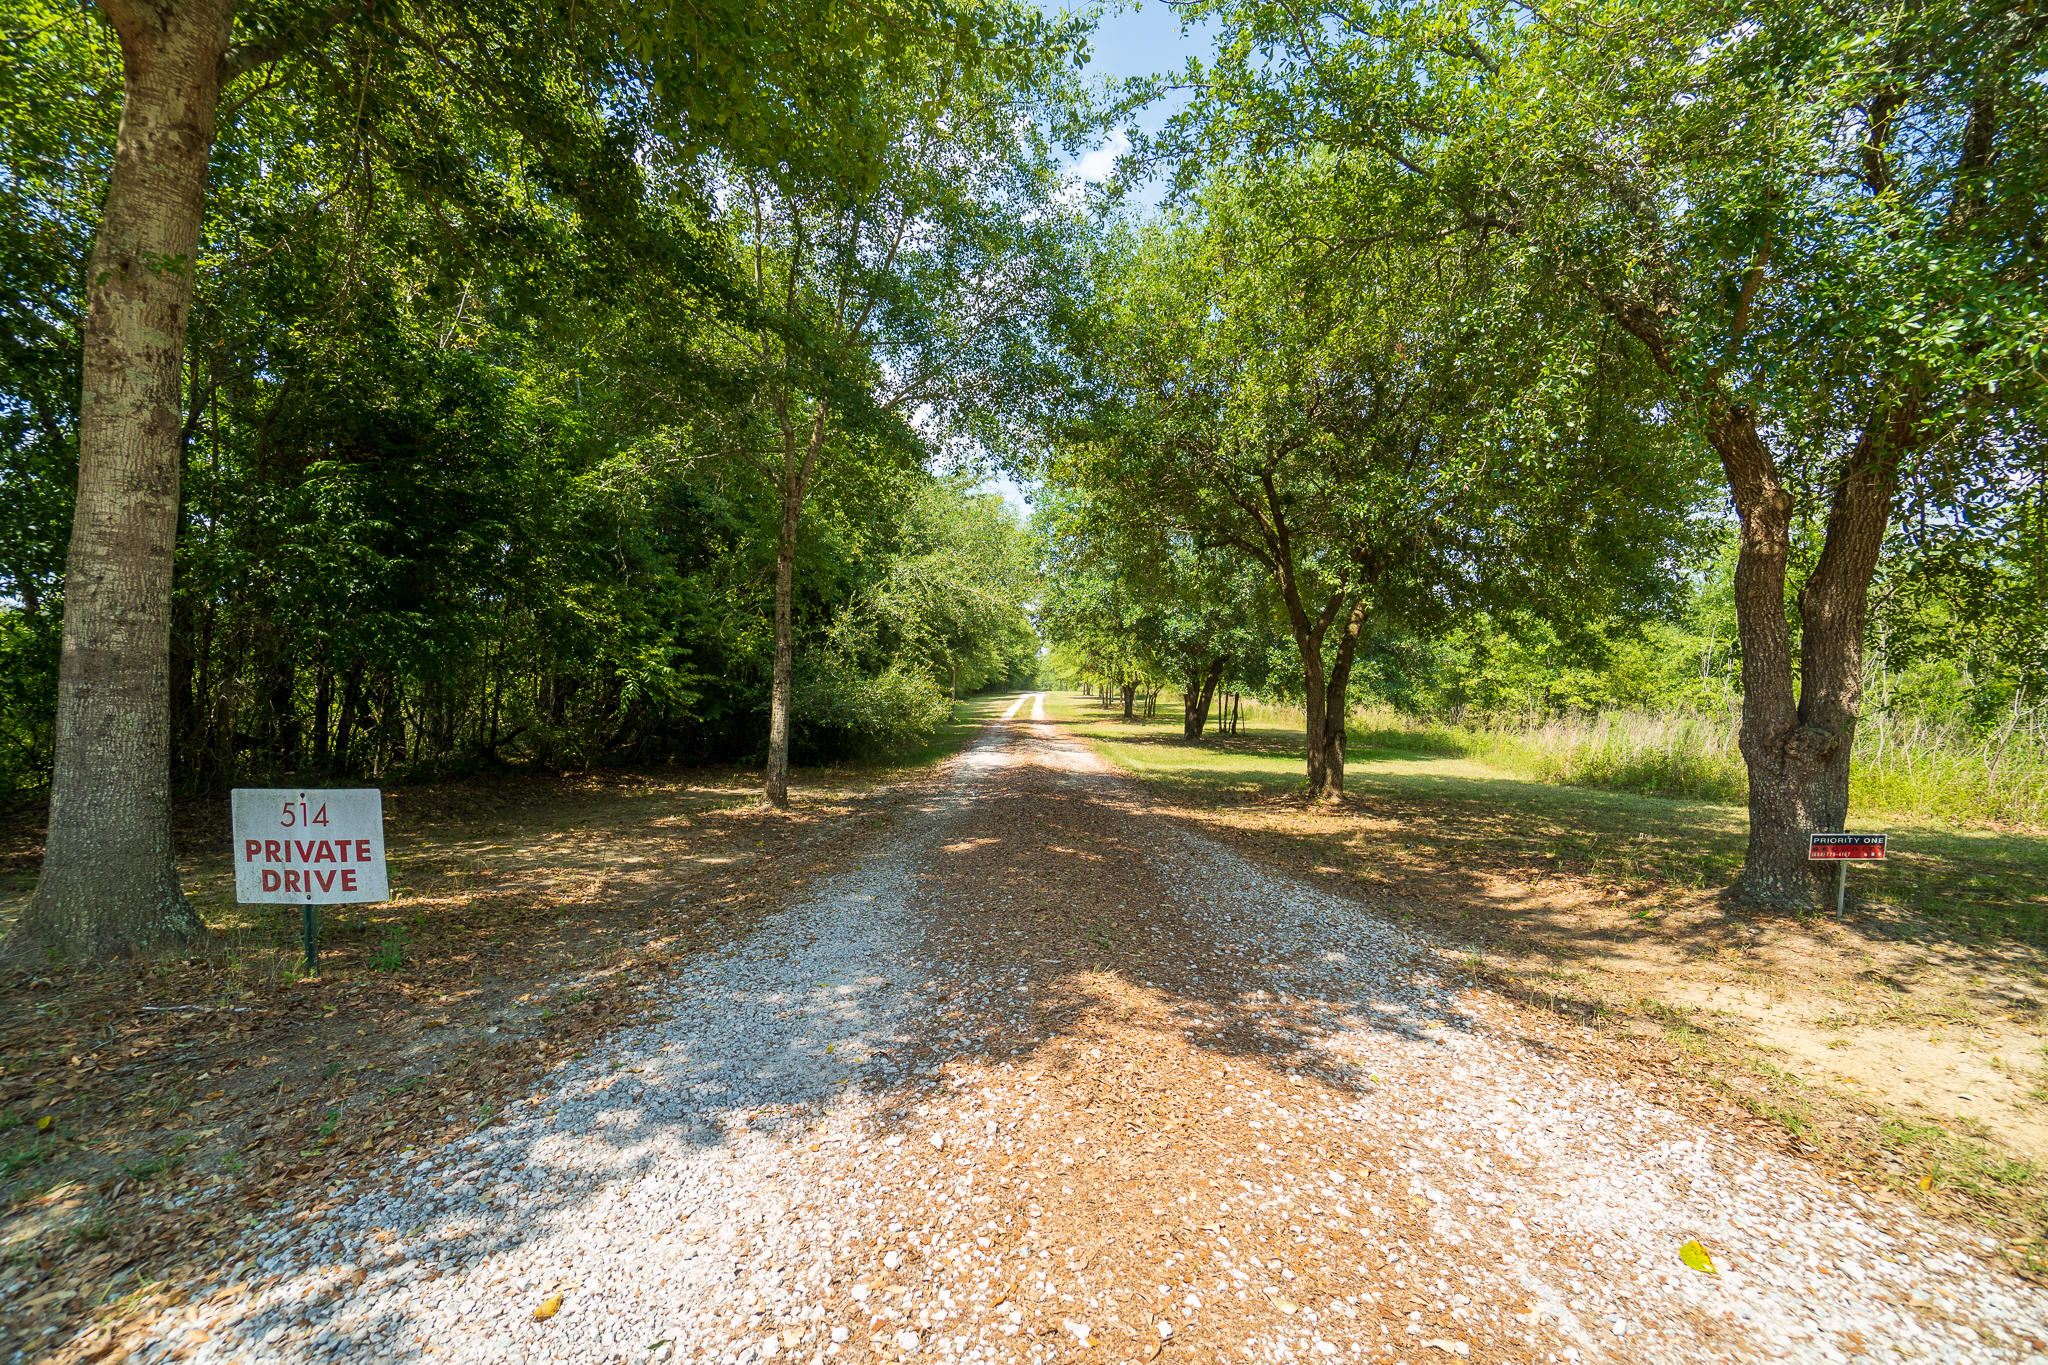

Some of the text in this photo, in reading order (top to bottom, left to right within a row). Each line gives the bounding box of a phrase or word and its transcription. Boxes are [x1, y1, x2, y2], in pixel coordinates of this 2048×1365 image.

[280, 802, 330, 827] 514
[245, 839, 372, 863] PRIVATE
[261, 869, 358, 893] DRIVE
